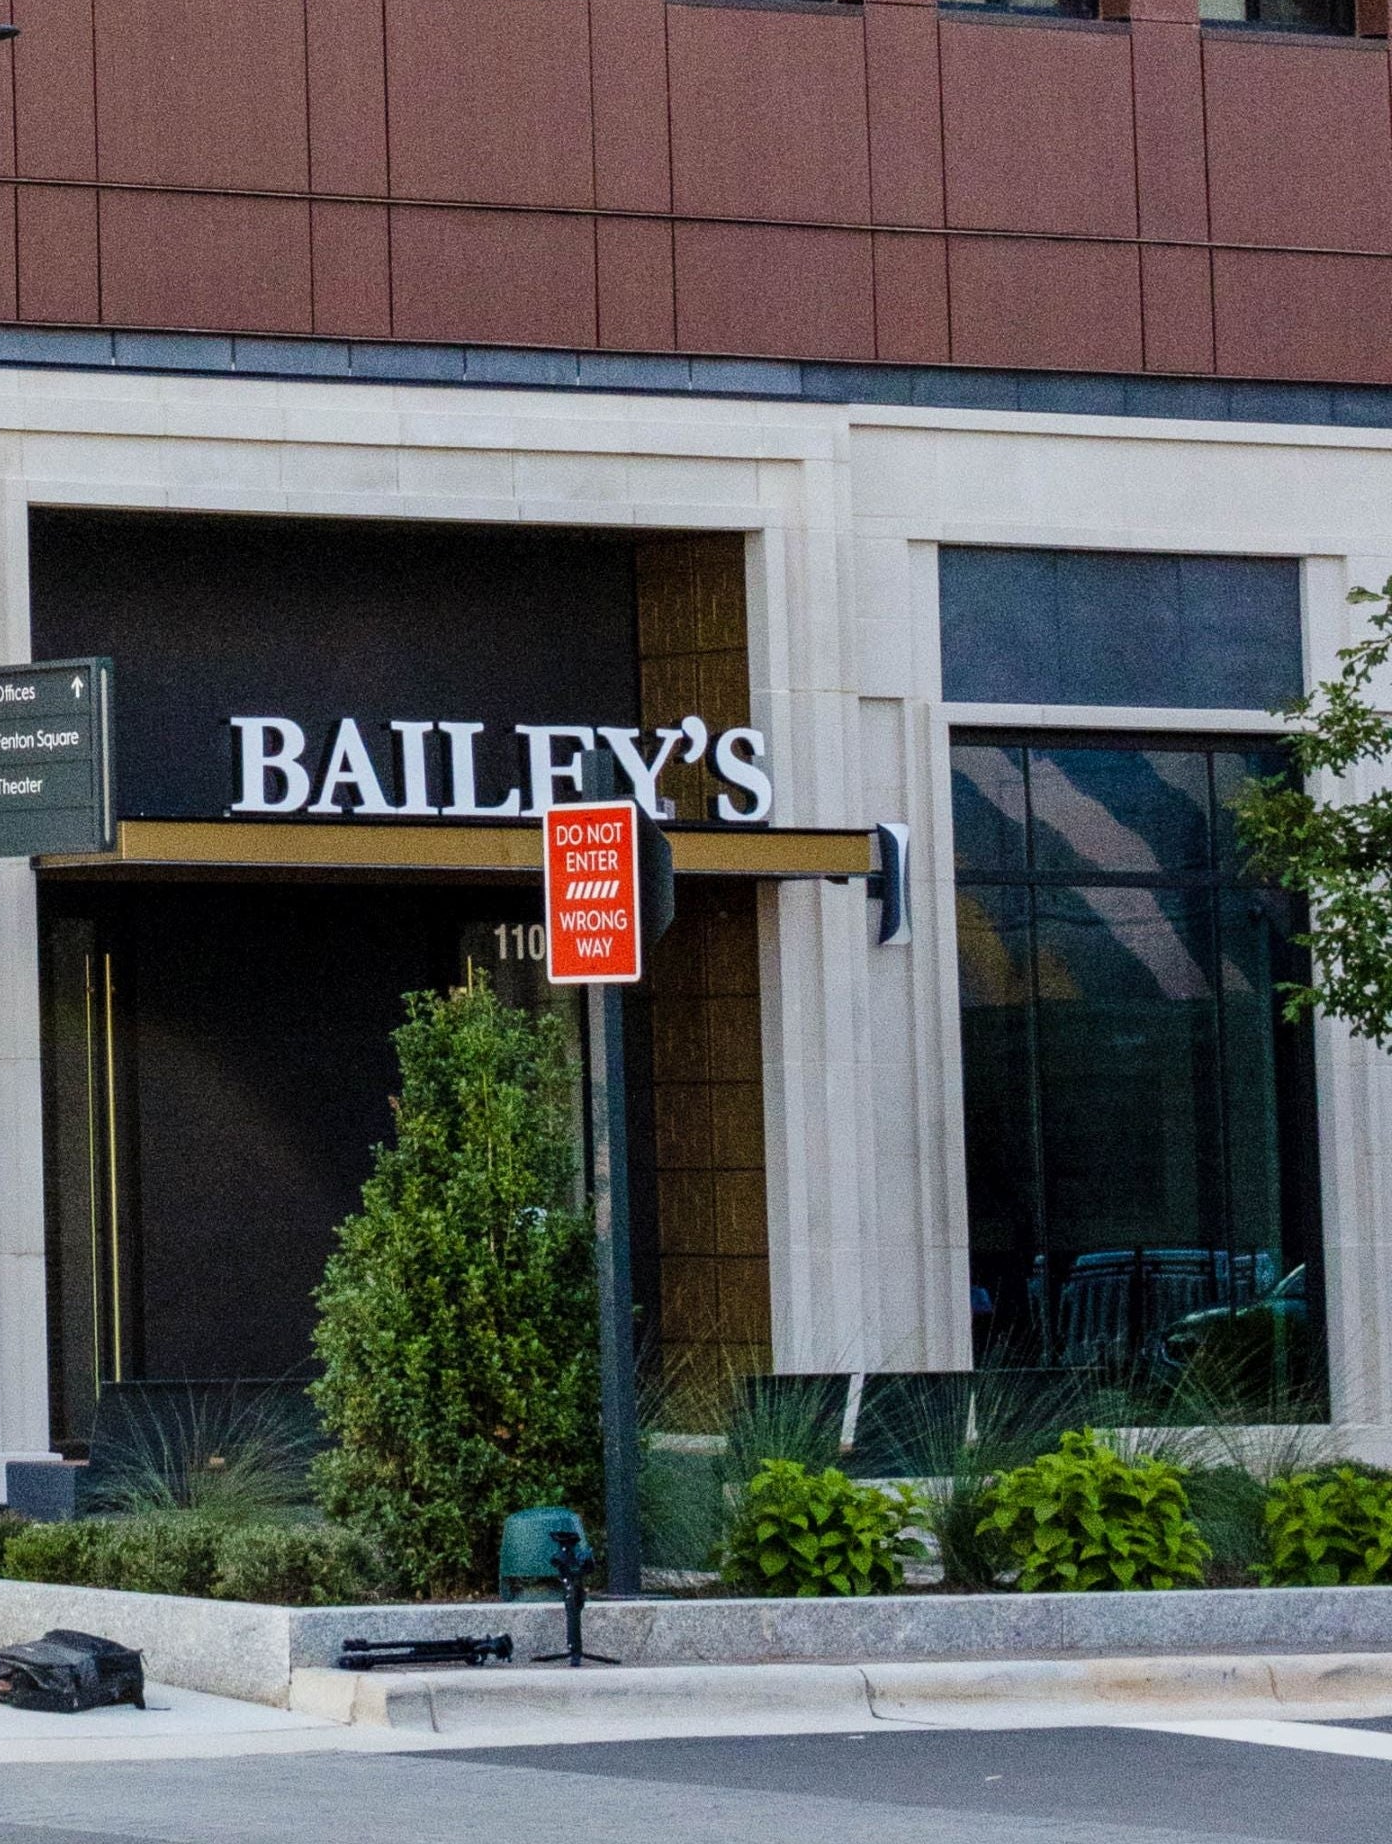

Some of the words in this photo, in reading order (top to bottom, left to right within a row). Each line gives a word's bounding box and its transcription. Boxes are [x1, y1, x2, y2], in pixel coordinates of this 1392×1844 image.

[37, 729, 79, 752] Square
[229, 715, 774, 822] BAILEY'S
[556, 825, 584, 846] DO
[587, 822, 624, 845] NOT
[566, 850, 619, 872] ENTER
[559, 909, 628, 932] WRONG
[575, 937, 614, 958] WAY
